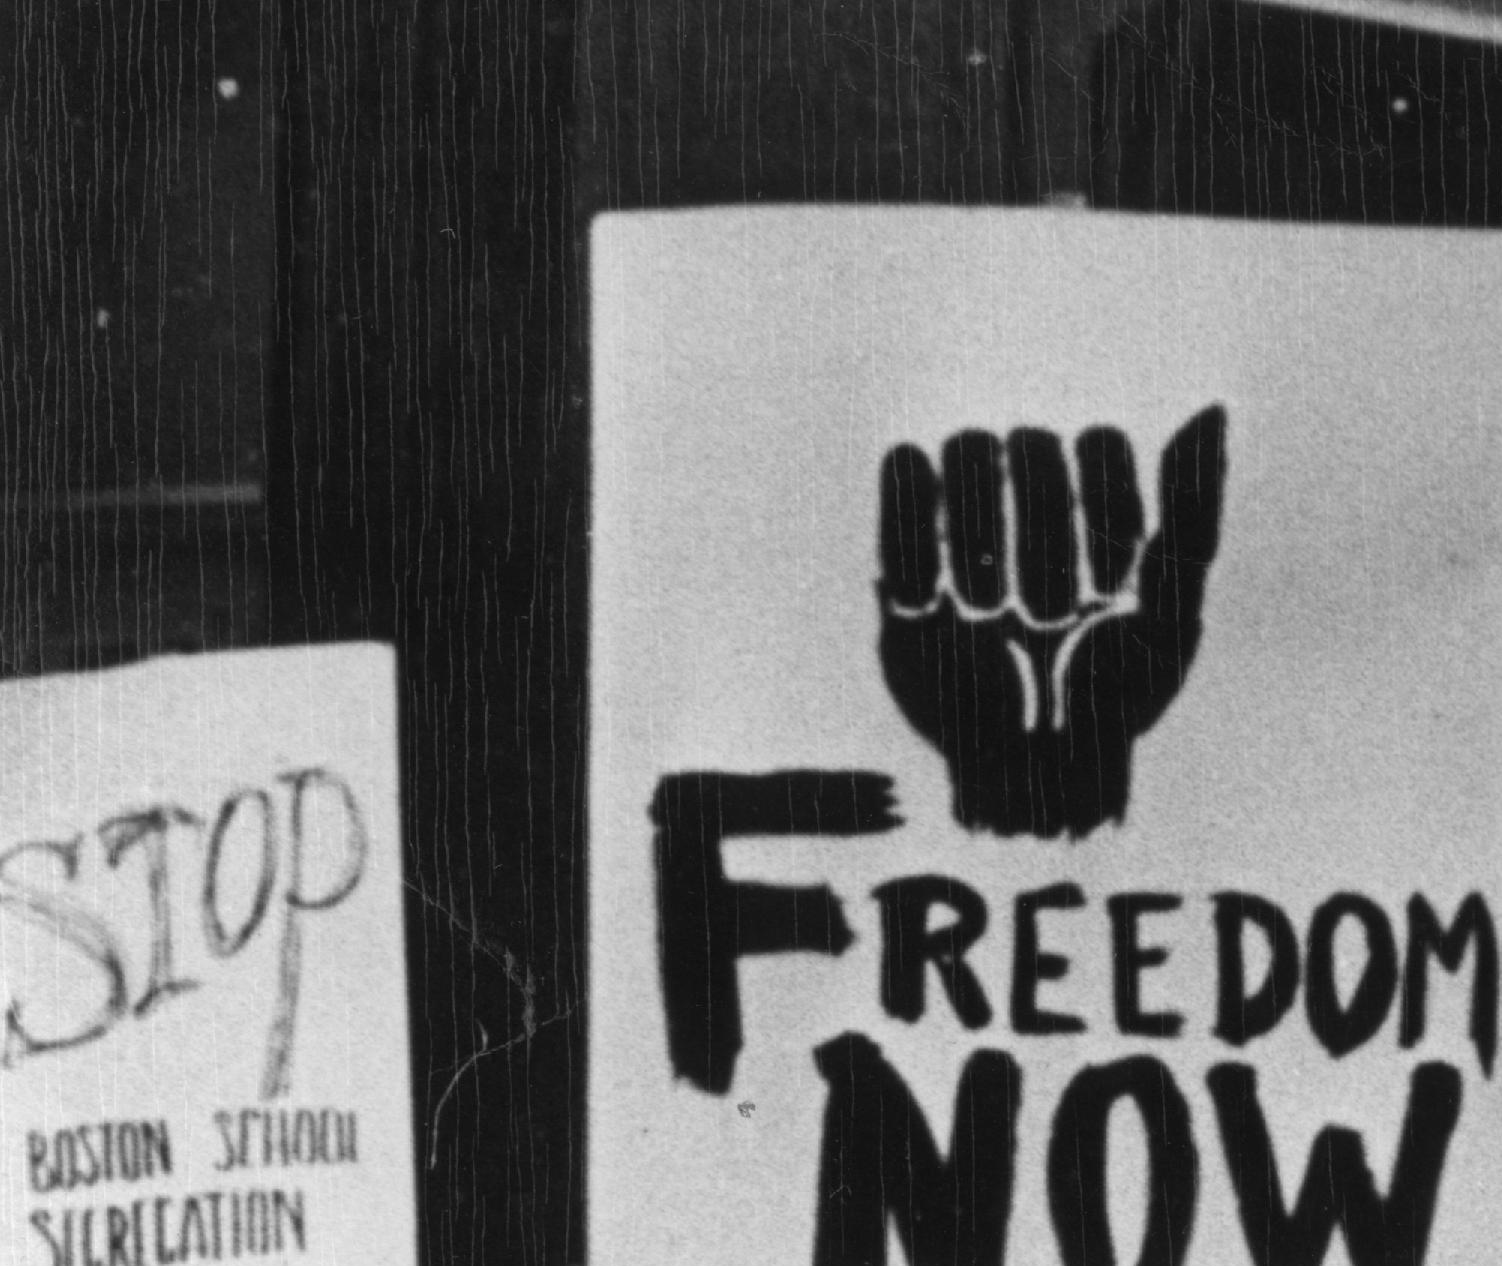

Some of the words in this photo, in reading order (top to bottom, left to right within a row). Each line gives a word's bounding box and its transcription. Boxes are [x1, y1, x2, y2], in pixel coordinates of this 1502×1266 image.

[0, 767, 369, 1100] STOP
[647, 770, 1501, 1096] FREEDOM
[26, 1118, 173, 1194] BOSTON
